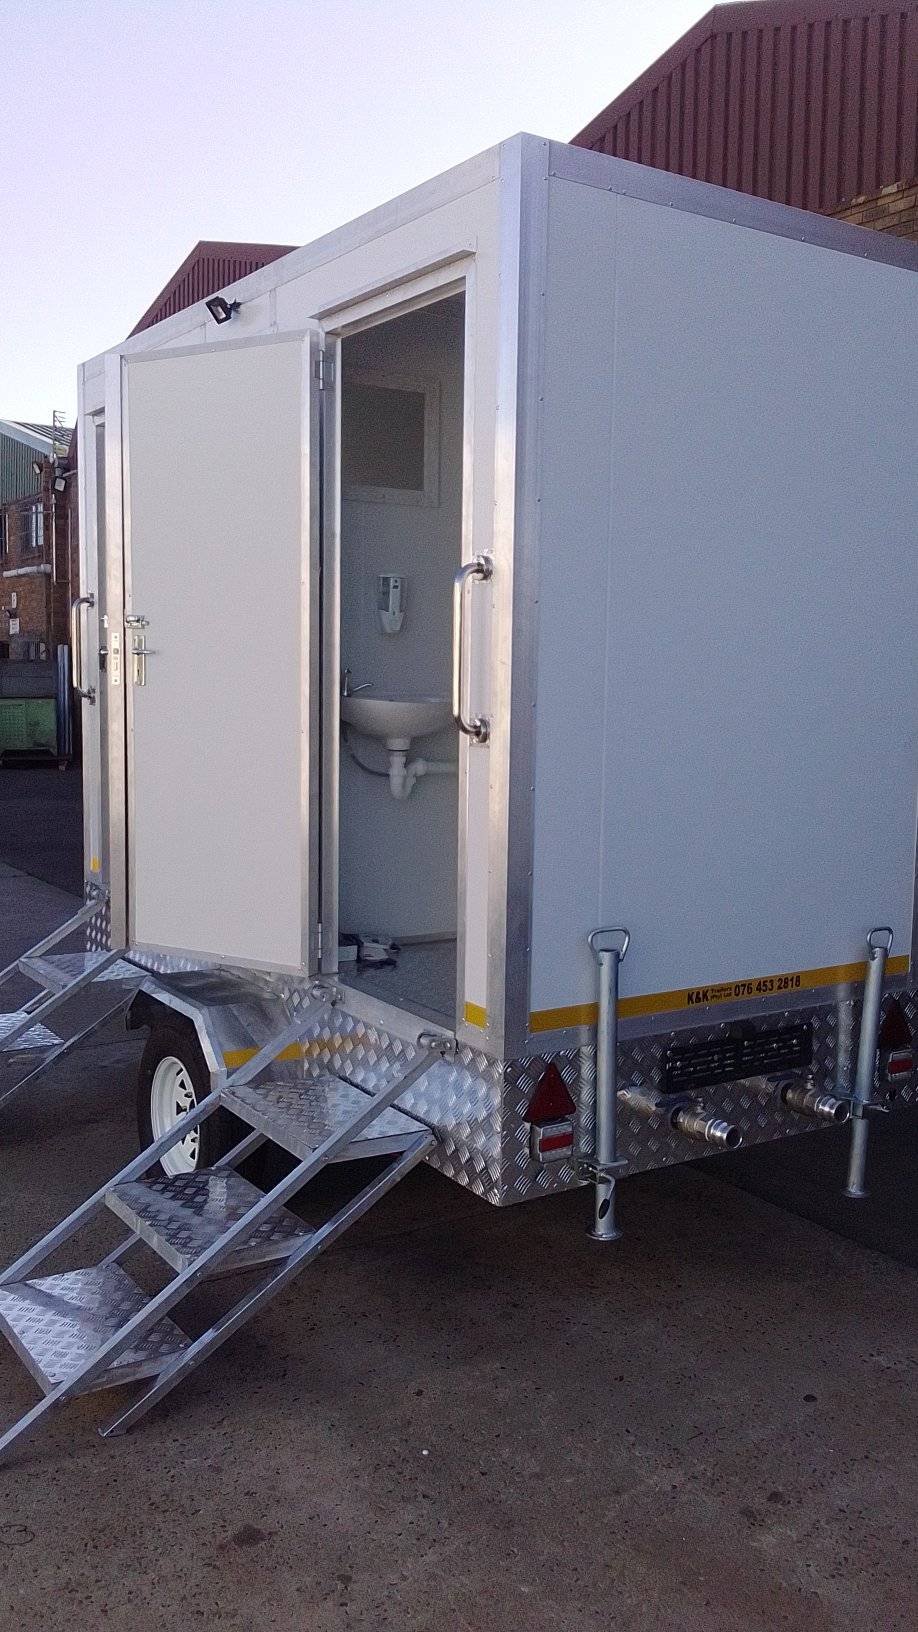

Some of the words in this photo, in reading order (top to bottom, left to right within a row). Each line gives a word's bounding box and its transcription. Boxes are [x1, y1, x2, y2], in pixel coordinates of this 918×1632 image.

[734, 983, 753, 997] 076
[756, 979, 774, 993] 453
[777, 975, 801, 990] 2818
[687, 989, 709, 1005] K&K
